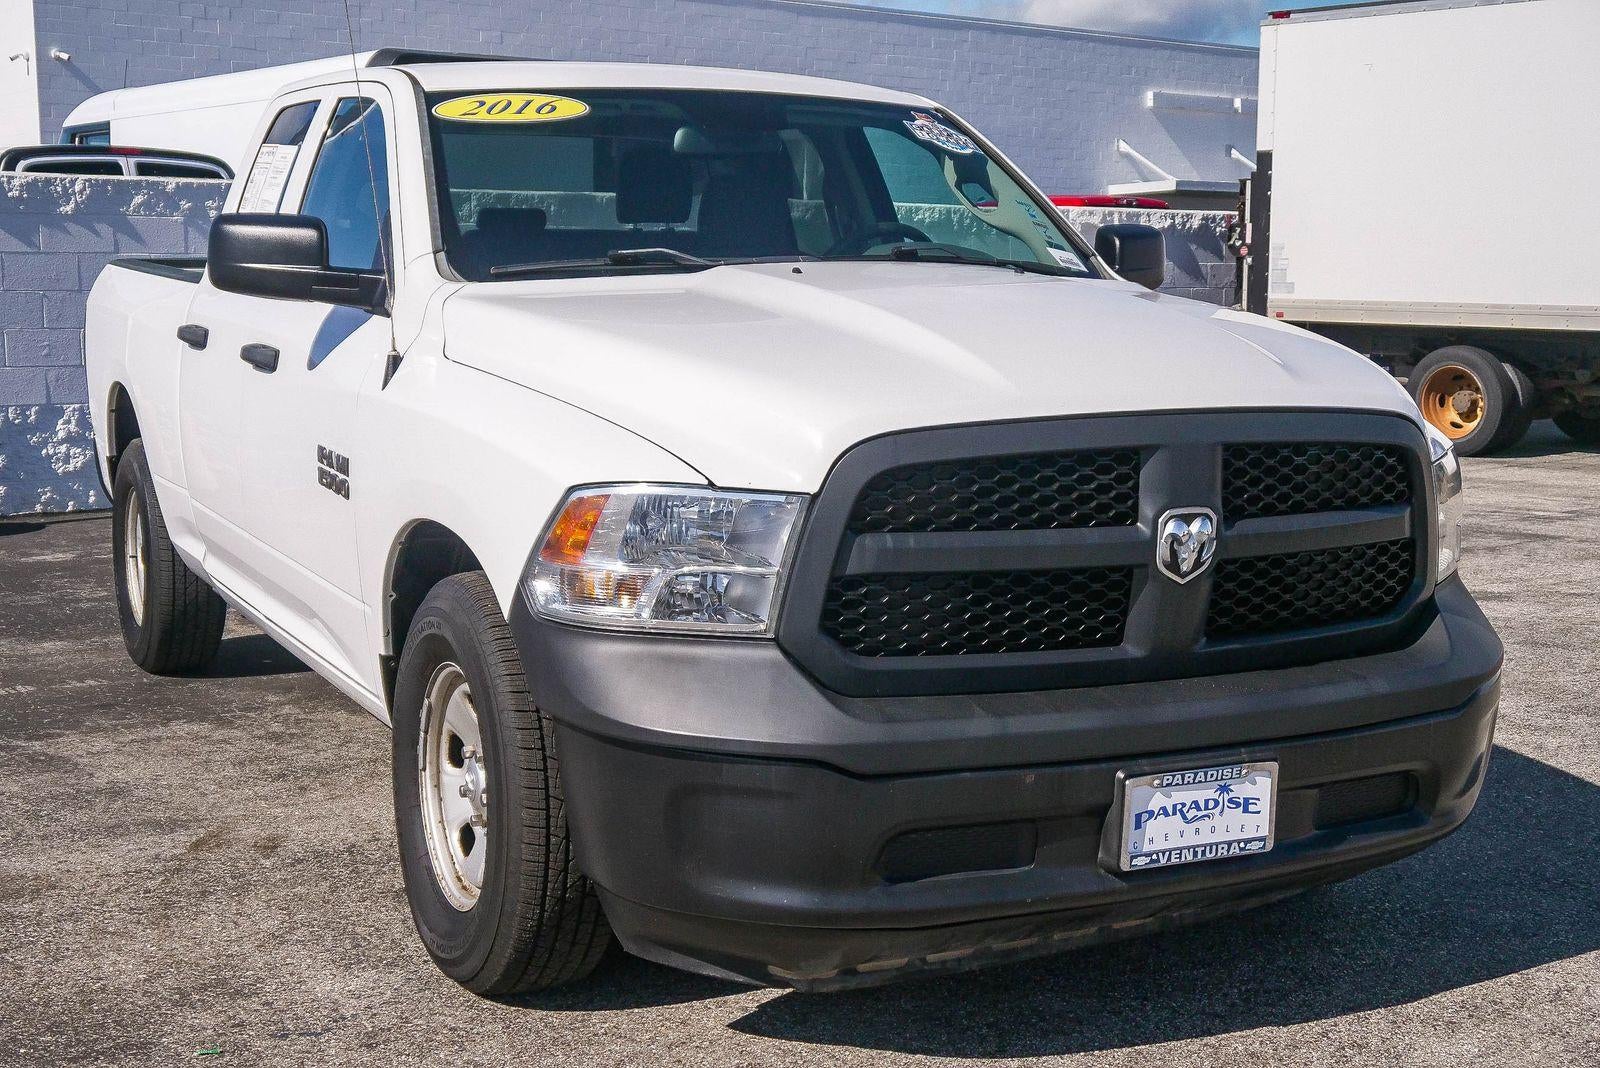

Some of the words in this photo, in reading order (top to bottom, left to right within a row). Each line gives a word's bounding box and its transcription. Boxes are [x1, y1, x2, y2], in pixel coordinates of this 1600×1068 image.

[459, 98, 563, 117] 2016
[1162, 767, 1242, 787] PARADISE
[1134, 782, 1262, 830] PARADISE
[1133, 824, 1261, 850] CHEVROLET
[1157, 842, 1240, 864] VENTURA
